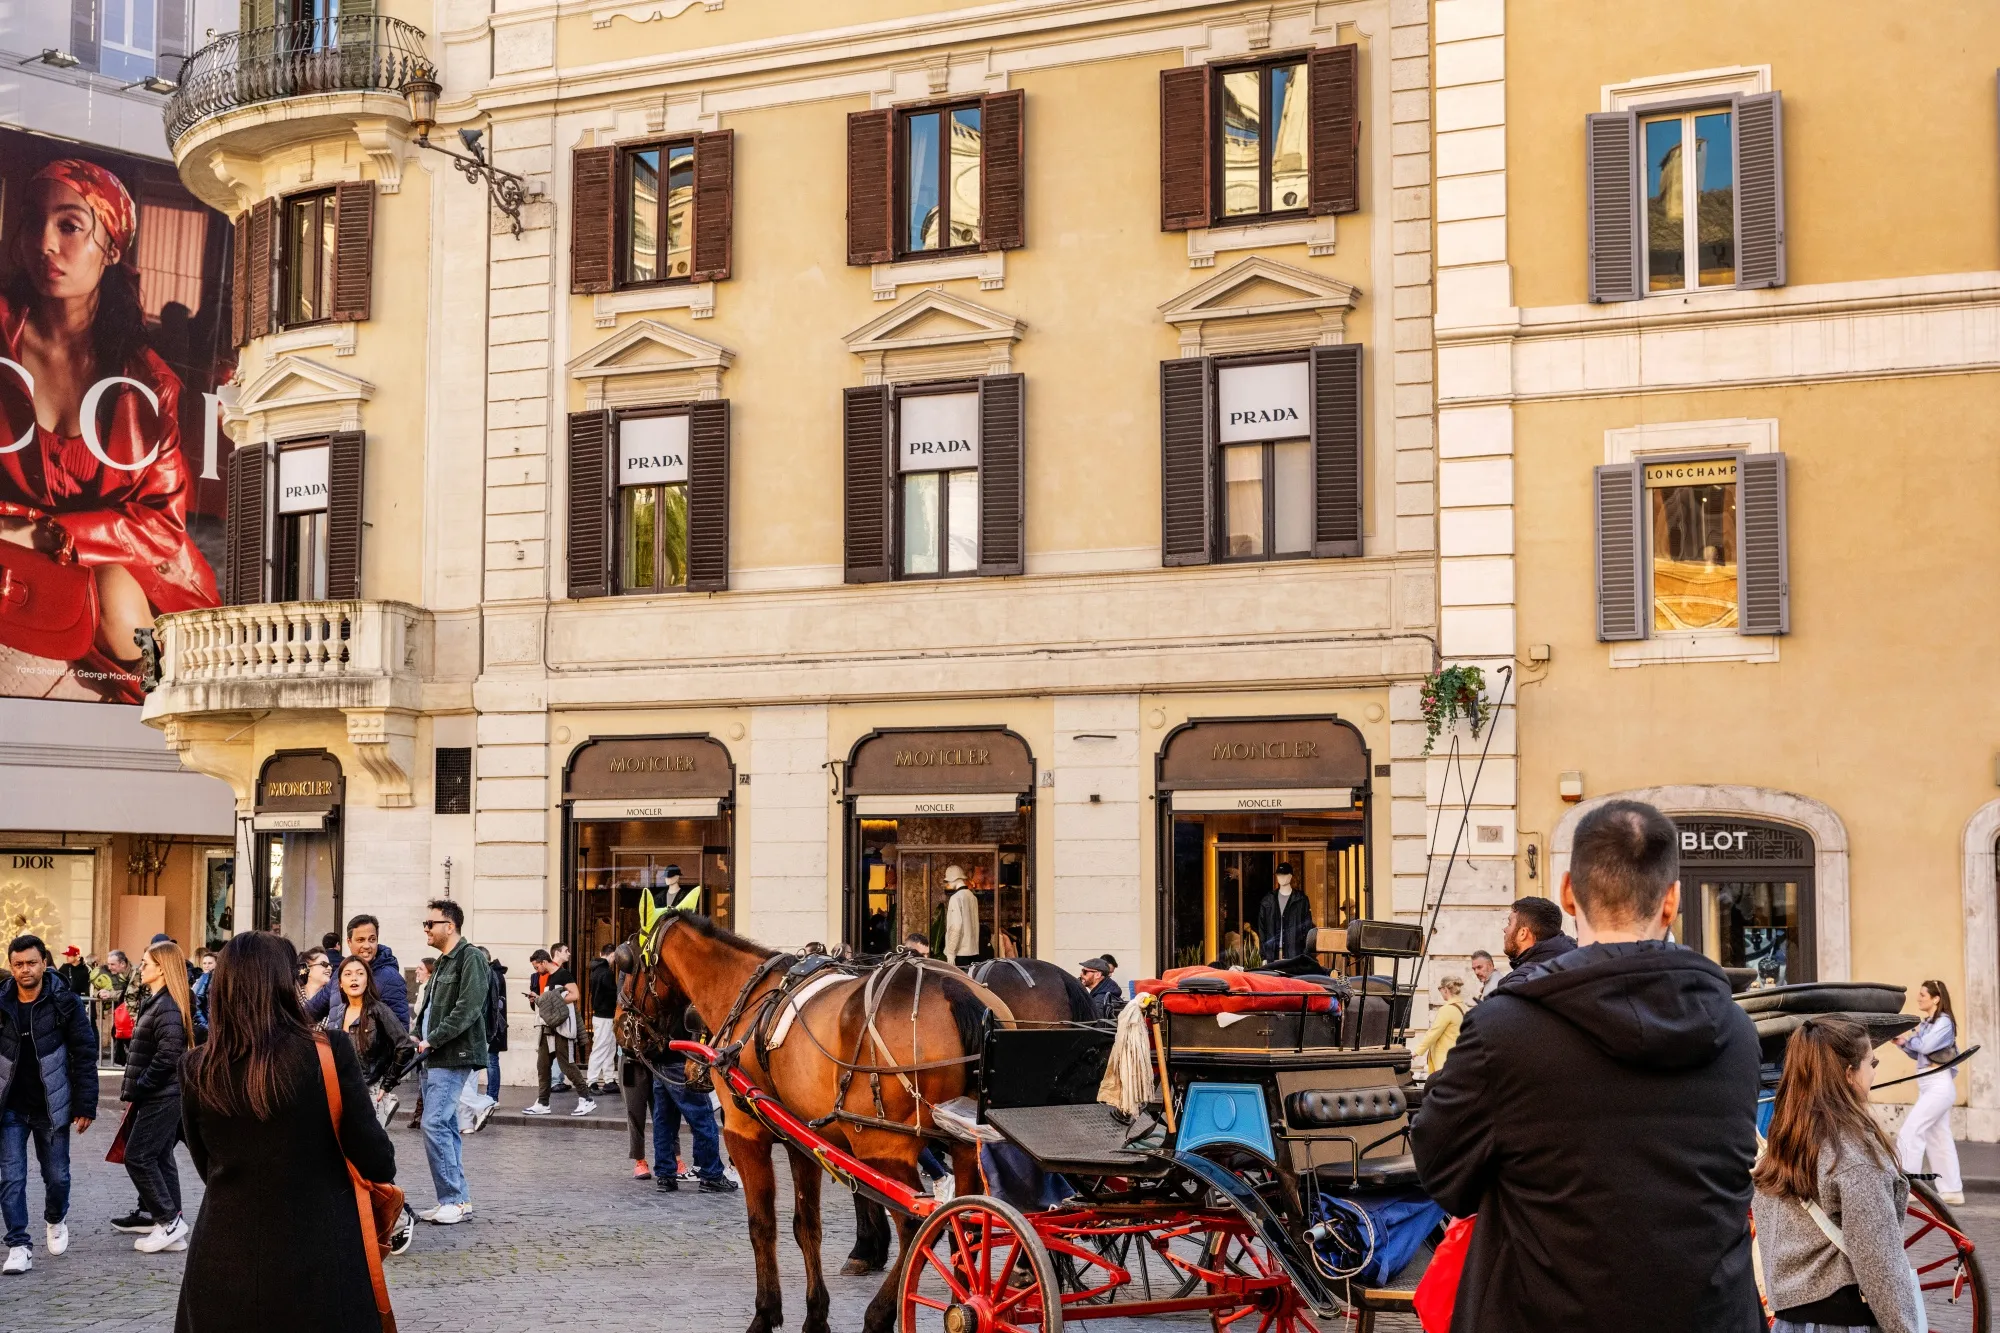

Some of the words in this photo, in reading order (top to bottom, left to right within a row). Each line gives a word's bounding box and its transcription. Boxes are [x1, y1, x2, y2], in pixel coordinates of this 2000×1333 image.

[1230, 407, 1299, 425] PRADA
[909, 439, 971, 455] PRADA
[628, 454, 684, 470] PRADA
[1647, 465, 1737, 480] LONGCHAMP
[286, 483, 328, 498] PRADA
[69, 669, 75, 677] &
[77, 669, 108, 681] George
[109, 671, 141, 682] MacKay
[894, 749, 991, 767] MONCLER
[1212, 741, 1320, 760] MONCLER
[609, 756, 696, 773] MONCLER
[268, 780, 333, 797] MONCLER
[914, 803, 955, 812] MONCLER
[1237, 798, 1282, 808] MONCLER
[626, 807, 663, 816] MONCLER
[273, 820, 300, 828] MONCLER
[1676, 831, 1748, 850] BLOT
[12, 855, 54, 869] DIOR
